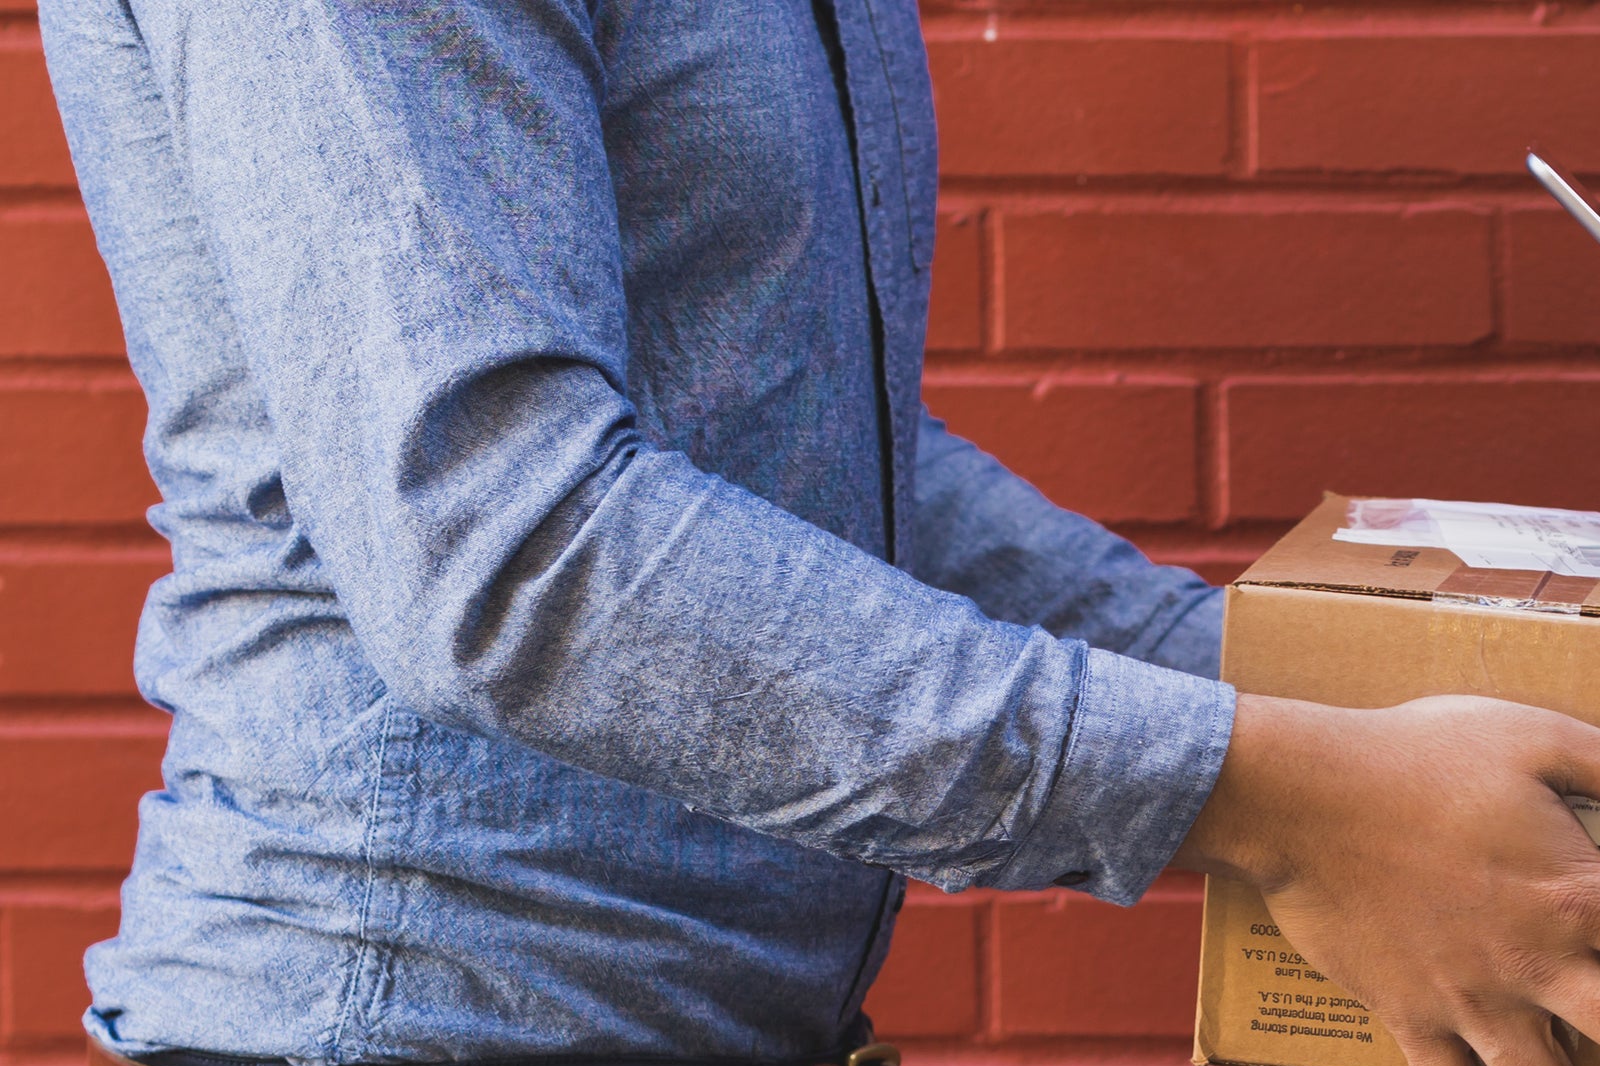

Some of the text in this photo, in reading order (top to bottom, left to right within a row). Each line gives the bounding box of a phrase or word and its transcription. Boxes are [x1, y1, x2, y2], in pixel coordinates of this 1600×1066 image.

[1250, 923, 1281, 937] 2009
[1241, 949, 1276, 962] U.S.A.
[1275, 968, 1329, 982] ffee Lane
[1258, 991, 1292, 1005] U.S.A.
[1295, 994, 1313, 1005] the
[1315, 996, 1327, 1007] of
[1258, 1007, 1370, 1026] at room temperature.
[1251, 1019, 1373, 1043] We recommend storing
